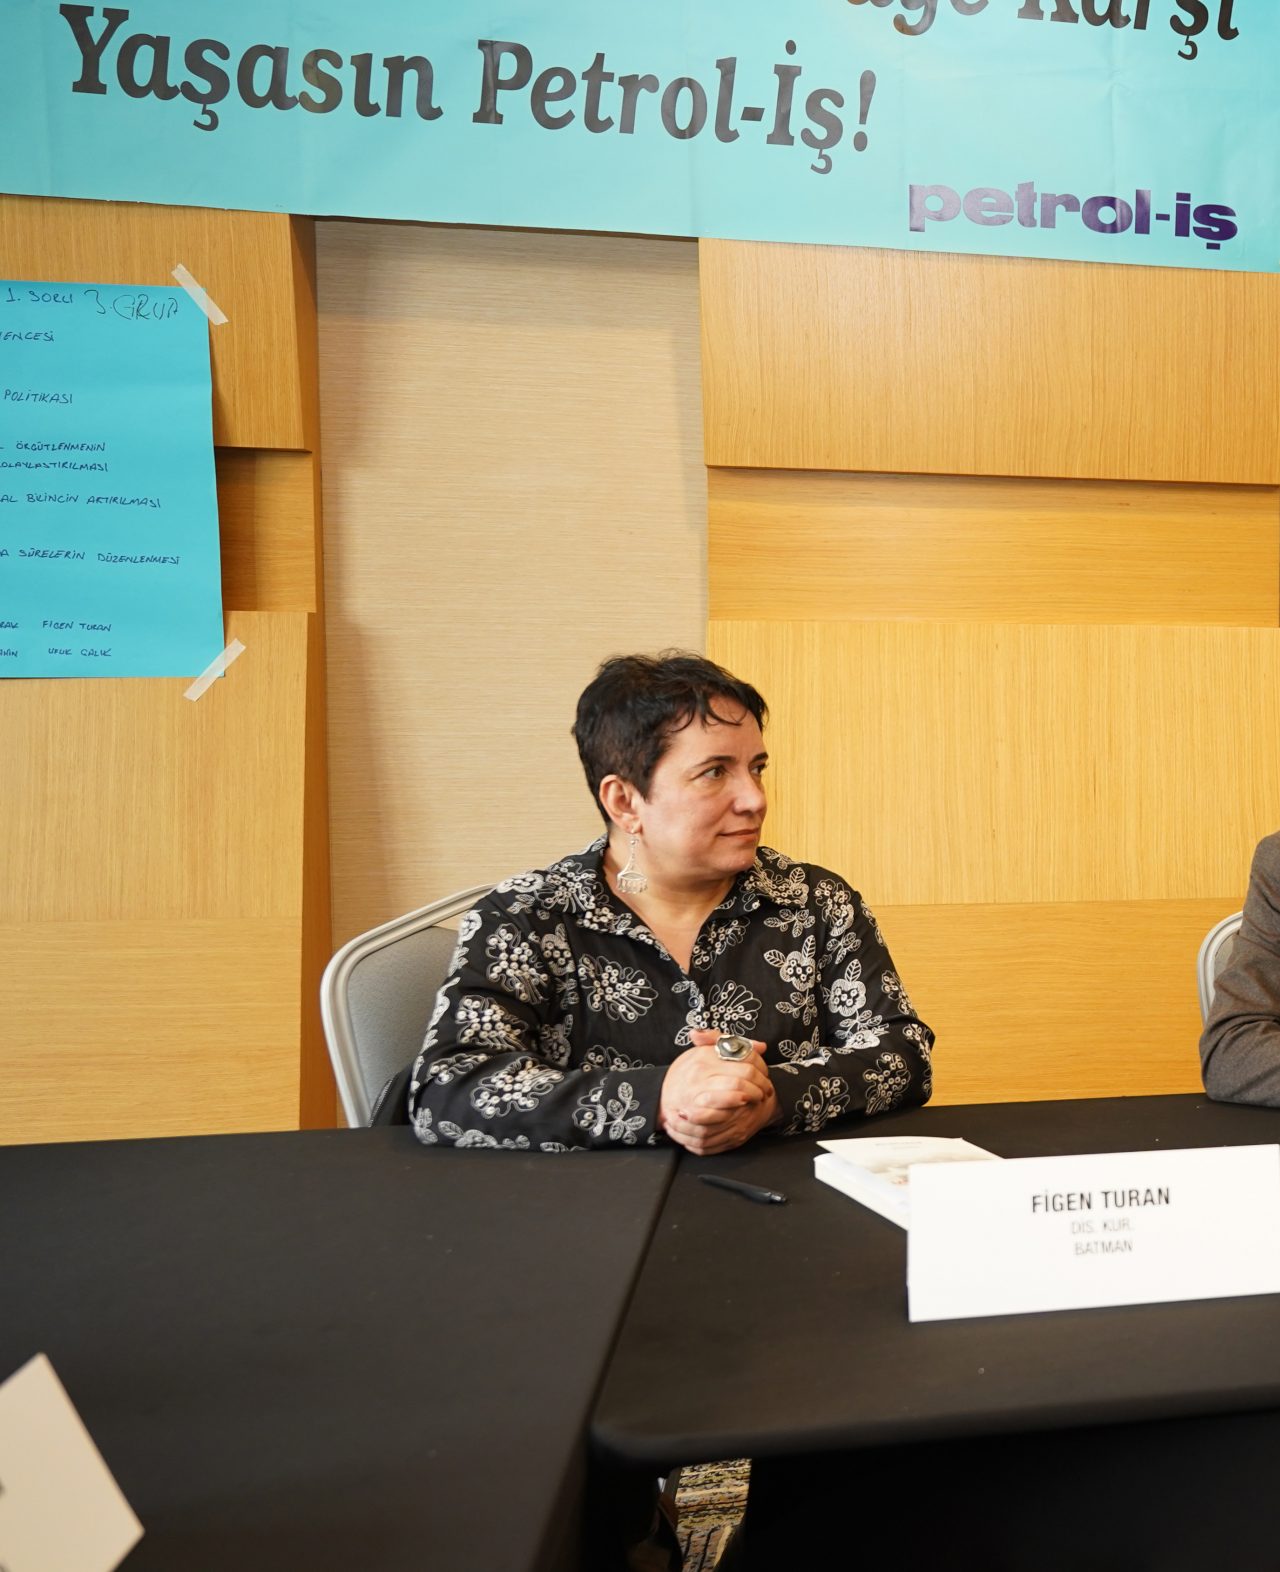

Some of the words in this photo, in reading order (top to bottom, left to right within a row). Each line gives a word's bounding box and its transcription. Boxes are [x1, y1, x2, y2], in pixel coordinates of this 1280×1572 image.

[59, 4, 443, 131] Yaşasın
[472, 39, 876, 175] Petrol-İş!
[908, 181, 1238, 250] petrol-iş
[28, 290, 74, 305] SORU
[1031, 1188, 1093, 1213] FİGEN
[1101, 1187, 1171, 1209] TURAN
[1074, 1238, 1134, 1256] BATMAN
